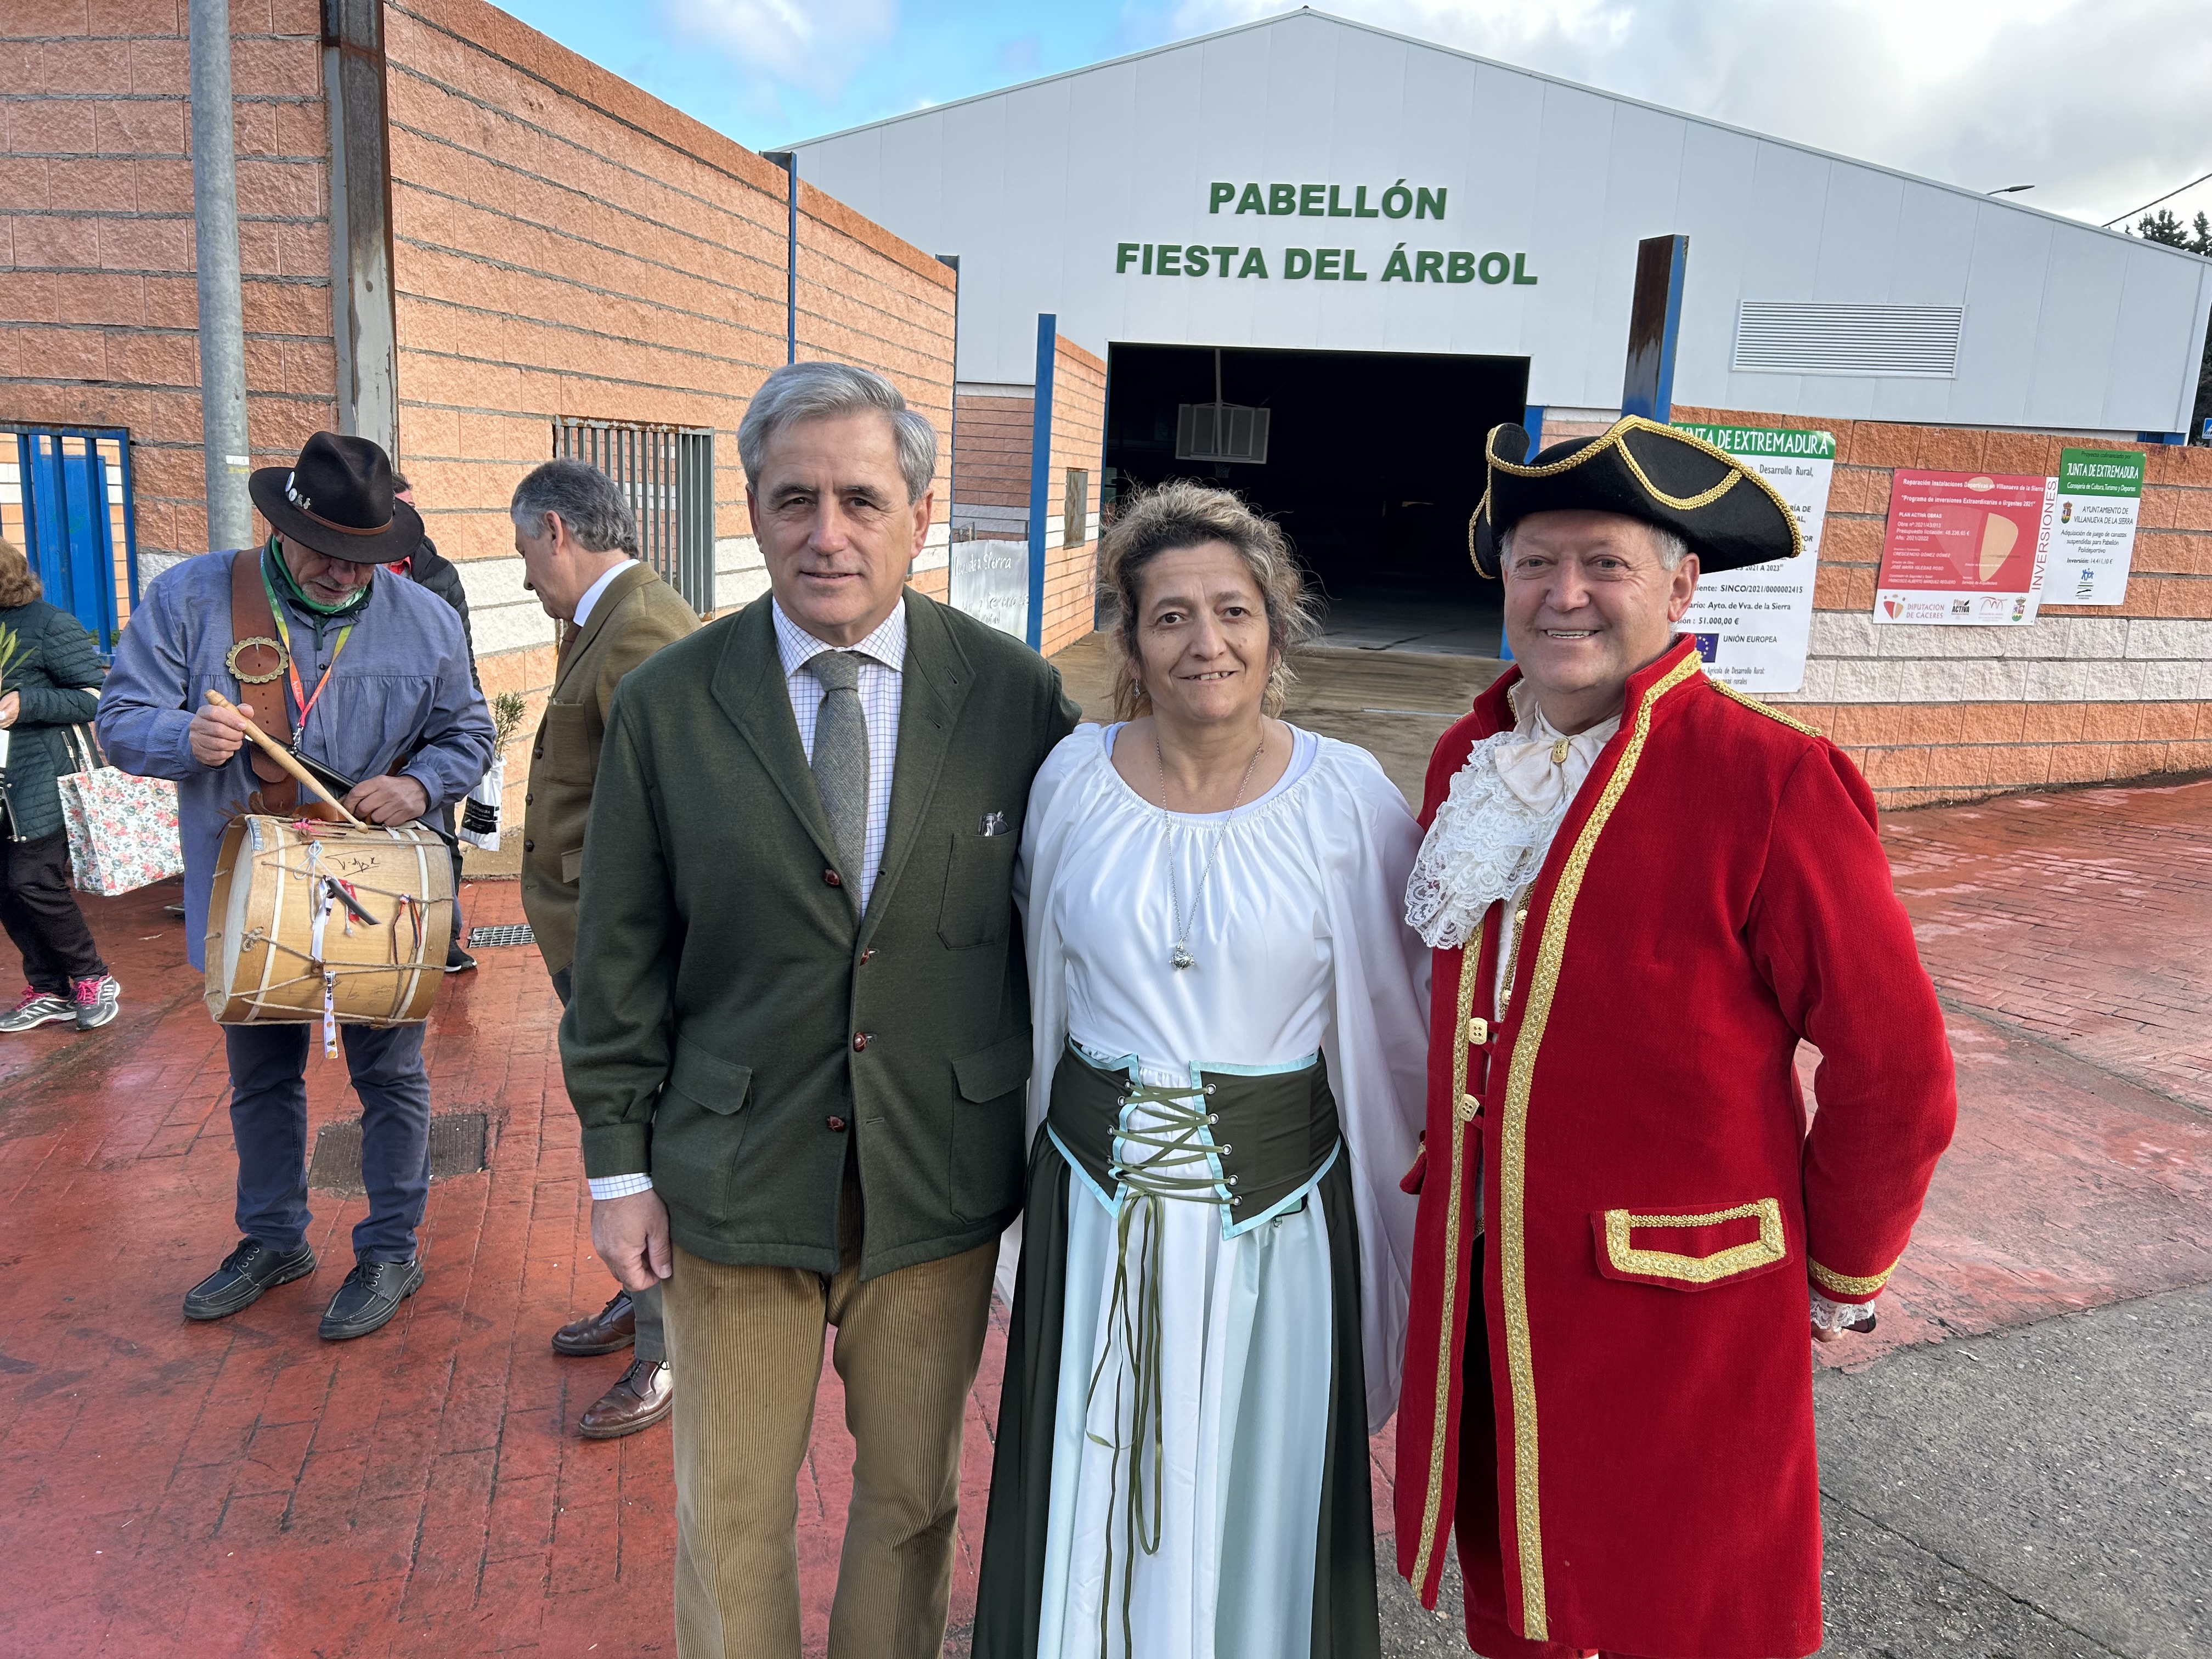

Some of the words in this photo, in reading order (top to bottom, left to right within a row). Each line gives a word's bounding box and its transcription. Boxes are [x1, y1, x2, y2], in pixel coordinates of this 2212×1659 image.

[1209, 178, 1447, 220] PABELLÓN
[1116, 242, 1268, 279] FIESTA
[1284, 248, 1367, 281] DEL
[1380, 242, 1538, 285] ÁRBOL
[1718, 430, 1732, 449] DE
[1734, 430, 1829, 455] EXTREMADURA
[1759, 464, 1792, 476] Desarrollo
[2067, 462, 2087, 476] JUNTA
[2089, 464, 2096, 477] DE
[2096, 464, 2138, 479] EXTREMADURA
[2082, 506, 2121, 514] AYUNTAMIENTO
[2074, 516, 2103, 524] VILLANUEVA
[2032, 481, 2056, 590] INVERSIONES
[1707, 602, 1726, 610] Ayto.
[1916, 611, 1943, 619] CÁCERES
[1699, 617, 1732, 625] 51.000,00
[1723, 634, 1745, 642] UNIÓN
